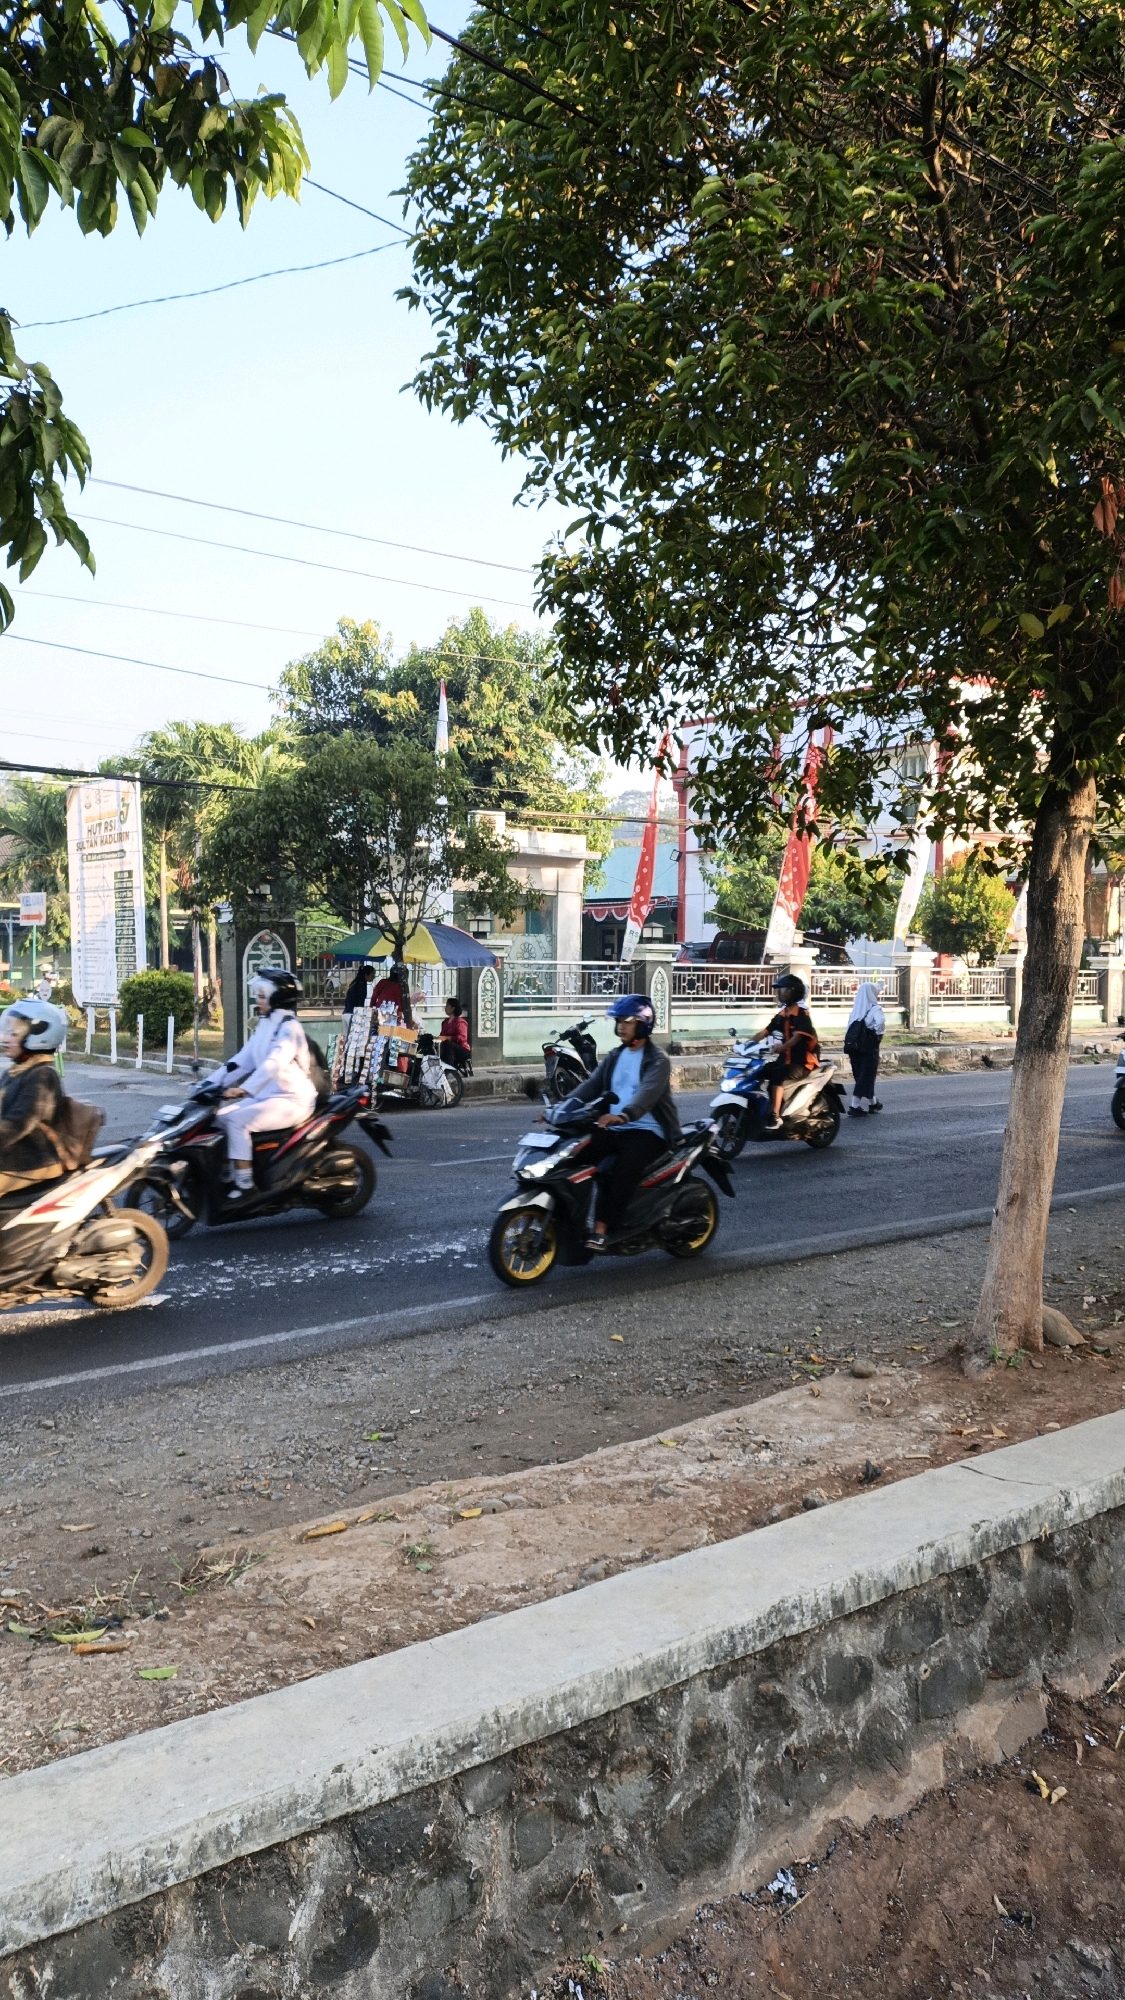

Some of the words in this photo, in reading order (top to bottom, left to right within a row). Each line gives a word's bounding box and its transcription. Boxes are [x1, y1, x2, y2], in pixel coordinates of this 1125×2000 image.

[87, 822, 102, 837] HUT
[104, 819, 117, 833] RSI
[76, 839, 98, 852] SULTAN
